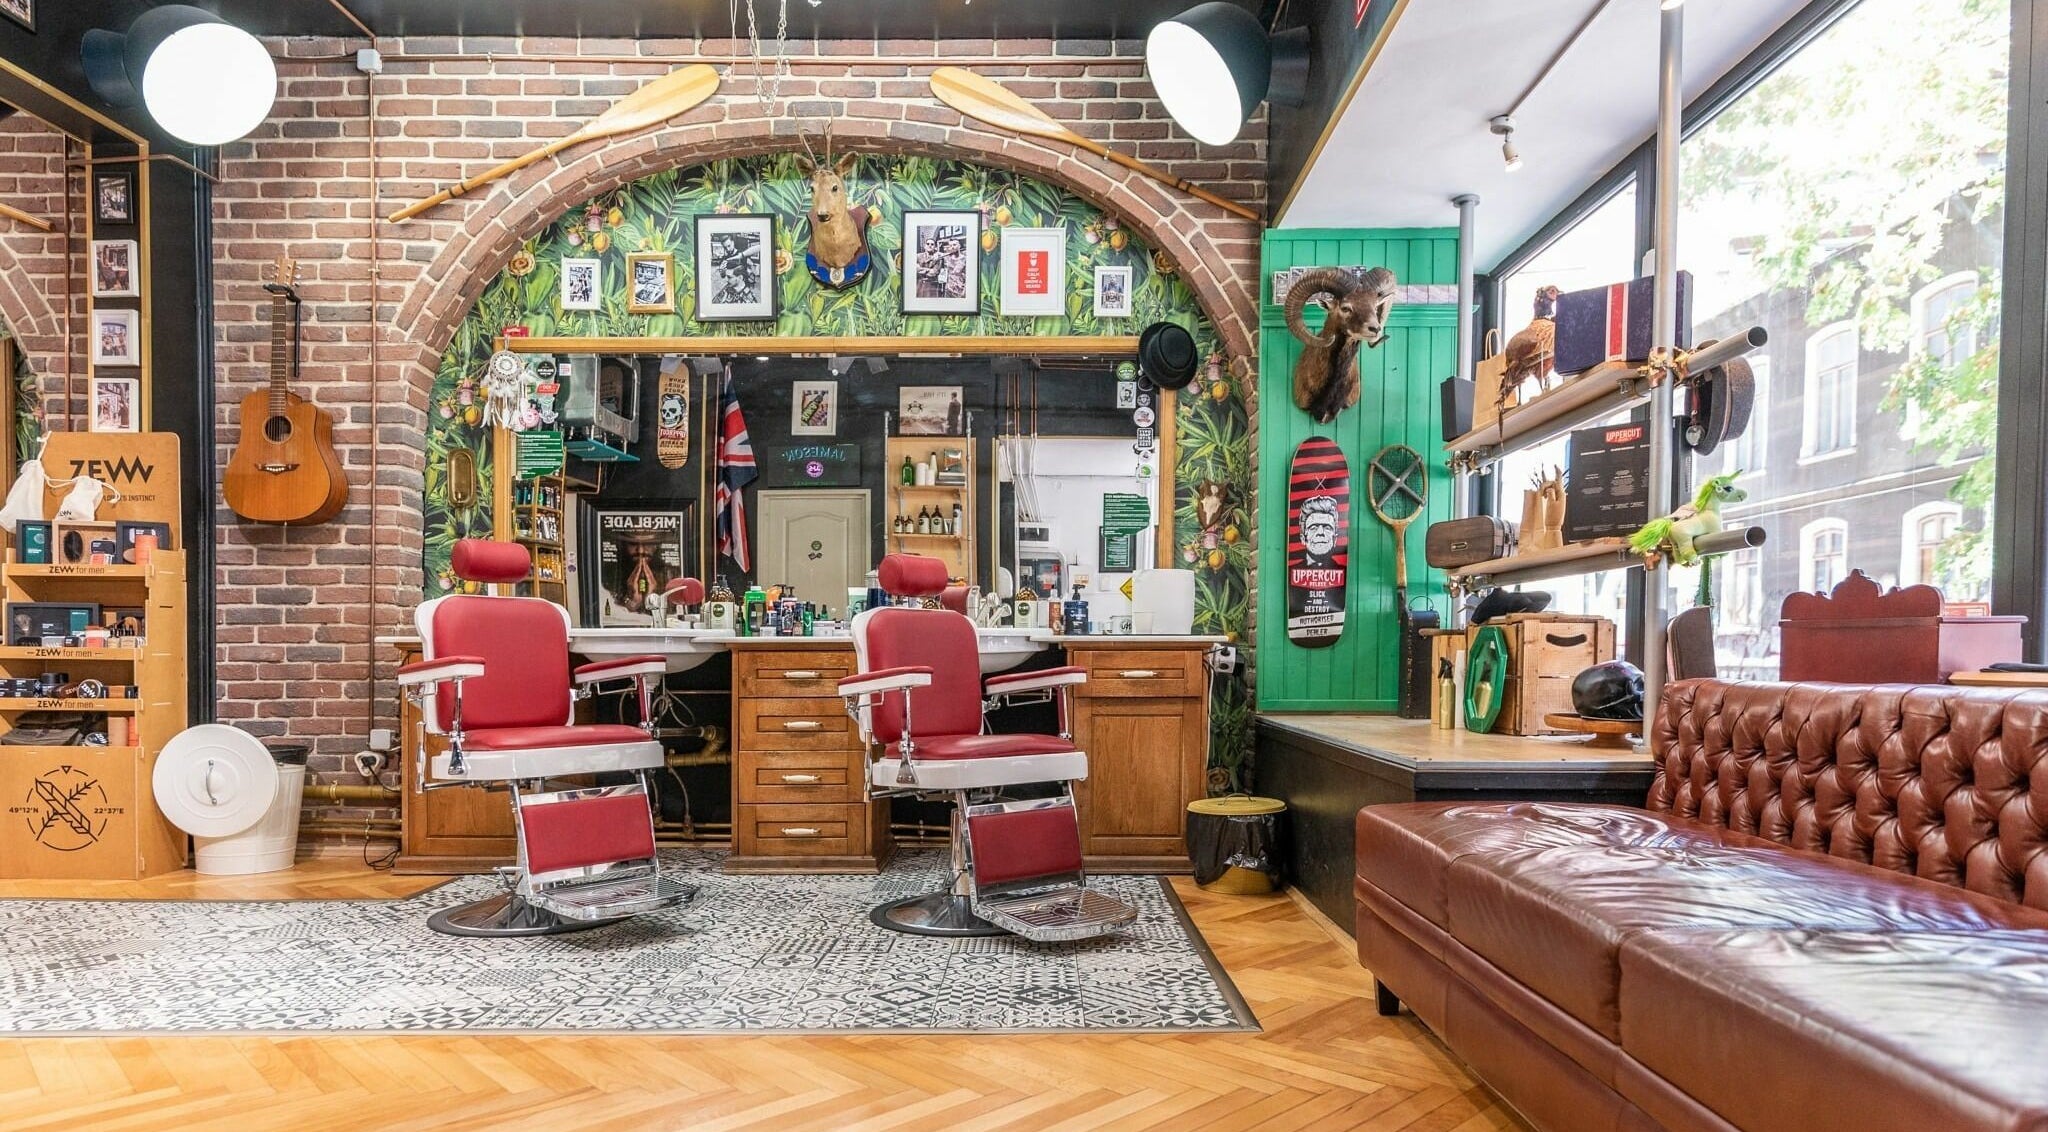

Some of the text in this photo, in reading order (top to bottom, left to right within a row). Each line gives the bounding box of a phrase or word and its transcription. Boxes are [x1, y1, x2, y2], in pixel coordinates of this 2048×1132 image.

[1606, 428, 1641, 441] UPPERCUT
[128, 494, 156, 502] INSTINCT
[76, 565, 87, 574] for
[1293, 570, 1343, 584] UPPERCUT
[1304, 605, 1330, 613] DESTROY
[1299, 615, 1334, 625] AUTHORISED
[1306, 628, 1328, 636] DEALER
[63, 649, 74, 657] for
